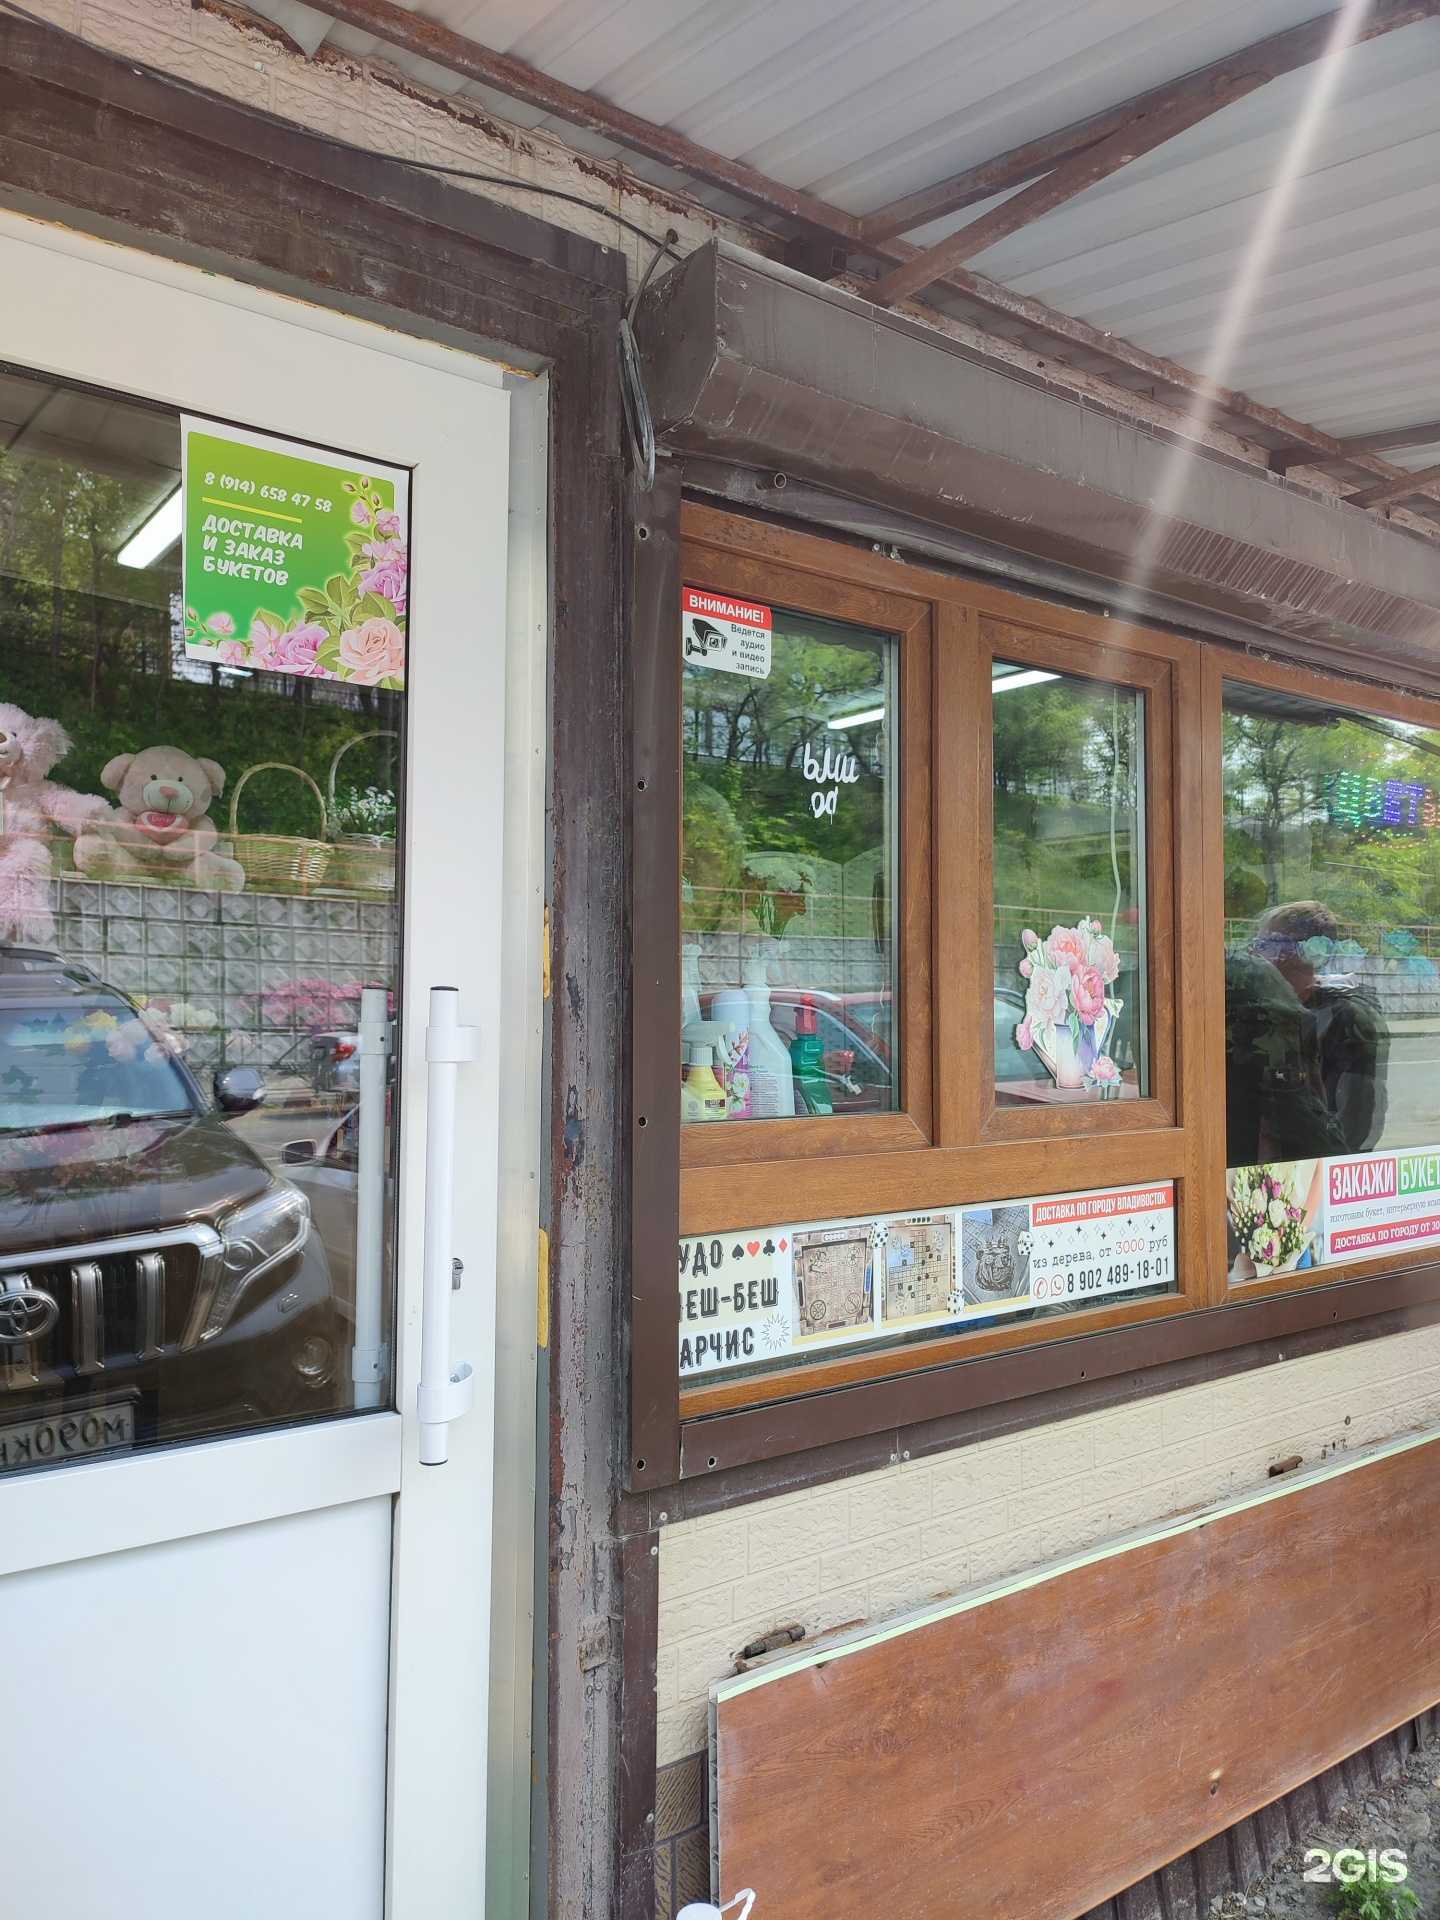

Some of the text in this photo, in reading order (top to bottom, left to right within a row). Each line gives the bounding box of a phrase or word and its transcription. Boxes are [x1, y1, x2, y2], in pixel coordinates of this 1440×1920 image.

[204, 472, 333, 513] 8 (914) 658 47 58
[202, 514, 303, 550] ДОСТАВКА
[203, 534, 286, 566] И ЗАКАЗ
[203, 555, 289, 586] БУКЕТОВ
[689, 594, 764, 624] ВНИМАНИЕ!
[731, 623, 765, 639] Ведется
[740, 640, 765, 652] аудио
[736, 662, 765, 675] запись
[740, 652, 765, 664] видео
[1332, 1160, 1394, 1201] ЗАКАЖИ
[1036, 1192, 1166, 1222] ДОСТАВКА ПО ГОРОДУ ВЛАДИВОСТОК
[1334, 1231, 1376, 1251] ДОСТАВКА
[1378, 1228, 1389, 1241] ПО
[1390, 1223, 1419, 1240] ГОРОДУ
[1420, 1221, 1431, 1233] ОТ
[1033, 1234, 1168, 1270] из дерева, от 3000 руб
[1067, 1256, 1169, 1293] 8 902 489-18-01
[680, 1277, 779, 1322] ЕШ-БЕШ
[680, 1326, 755, 1370] АРЧИС
